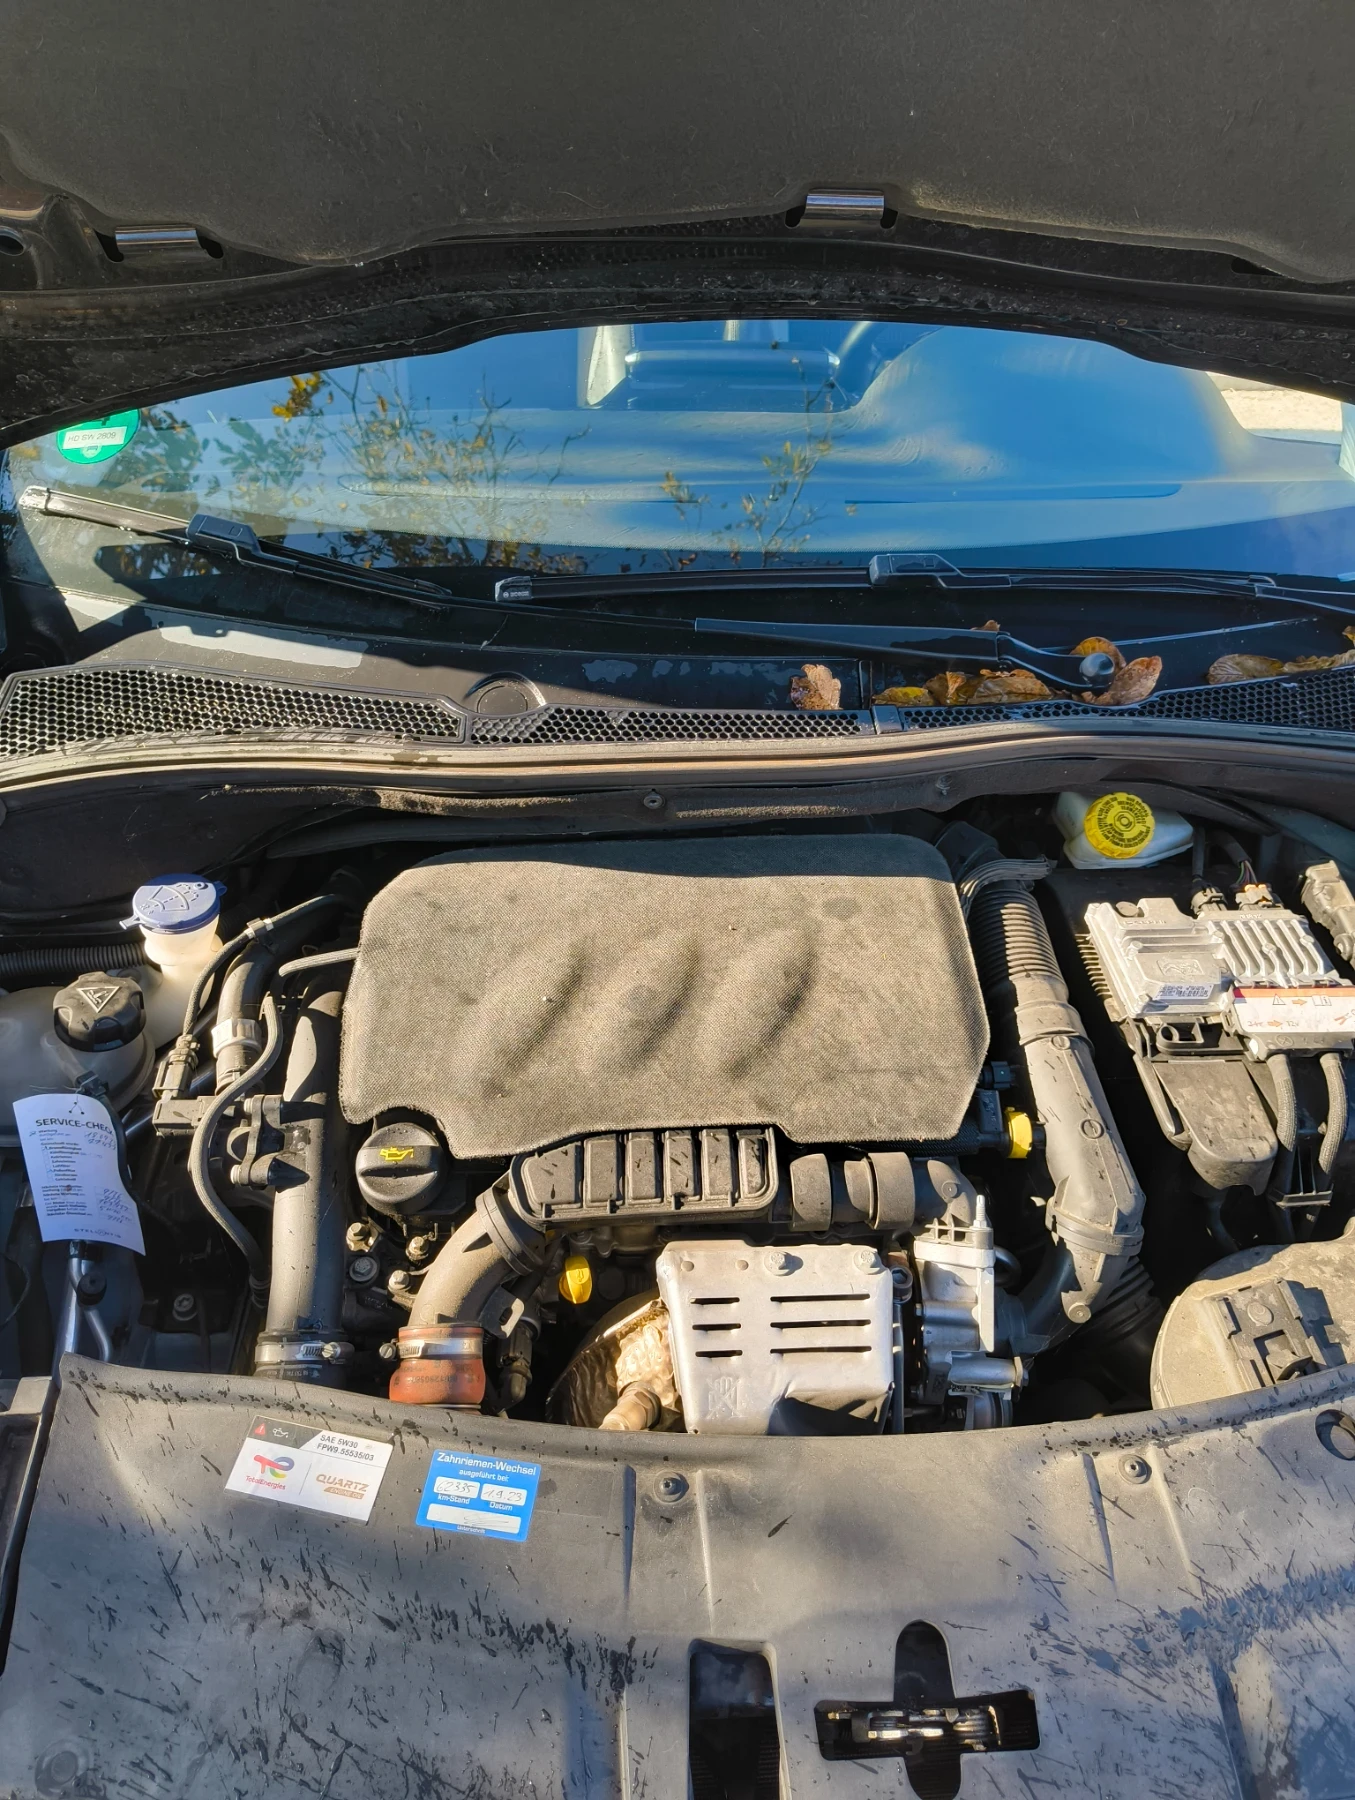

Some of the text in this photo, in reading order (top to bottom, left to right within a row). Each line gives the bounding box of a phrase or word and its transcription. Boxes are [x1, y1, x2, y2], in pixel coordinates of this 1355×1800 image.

[96, 431, 117, 440] 2809
[320, 1434, 359, 1449] SAE 5W30
[316, 1442, 376, 1462] FPW9.55535/03
[436, 1452, 537, 1476] Zahnriemen-Wechsel
[458, 1469, 496, 1481] ausgeführt
[245, 1475, 287, 1491] TotalEnergies
[315, 1473, 370, 1493] QUARTZ
[437, 1493, 471, 1505] km-Stand
[489, 1501, 513, 1511] Datum
